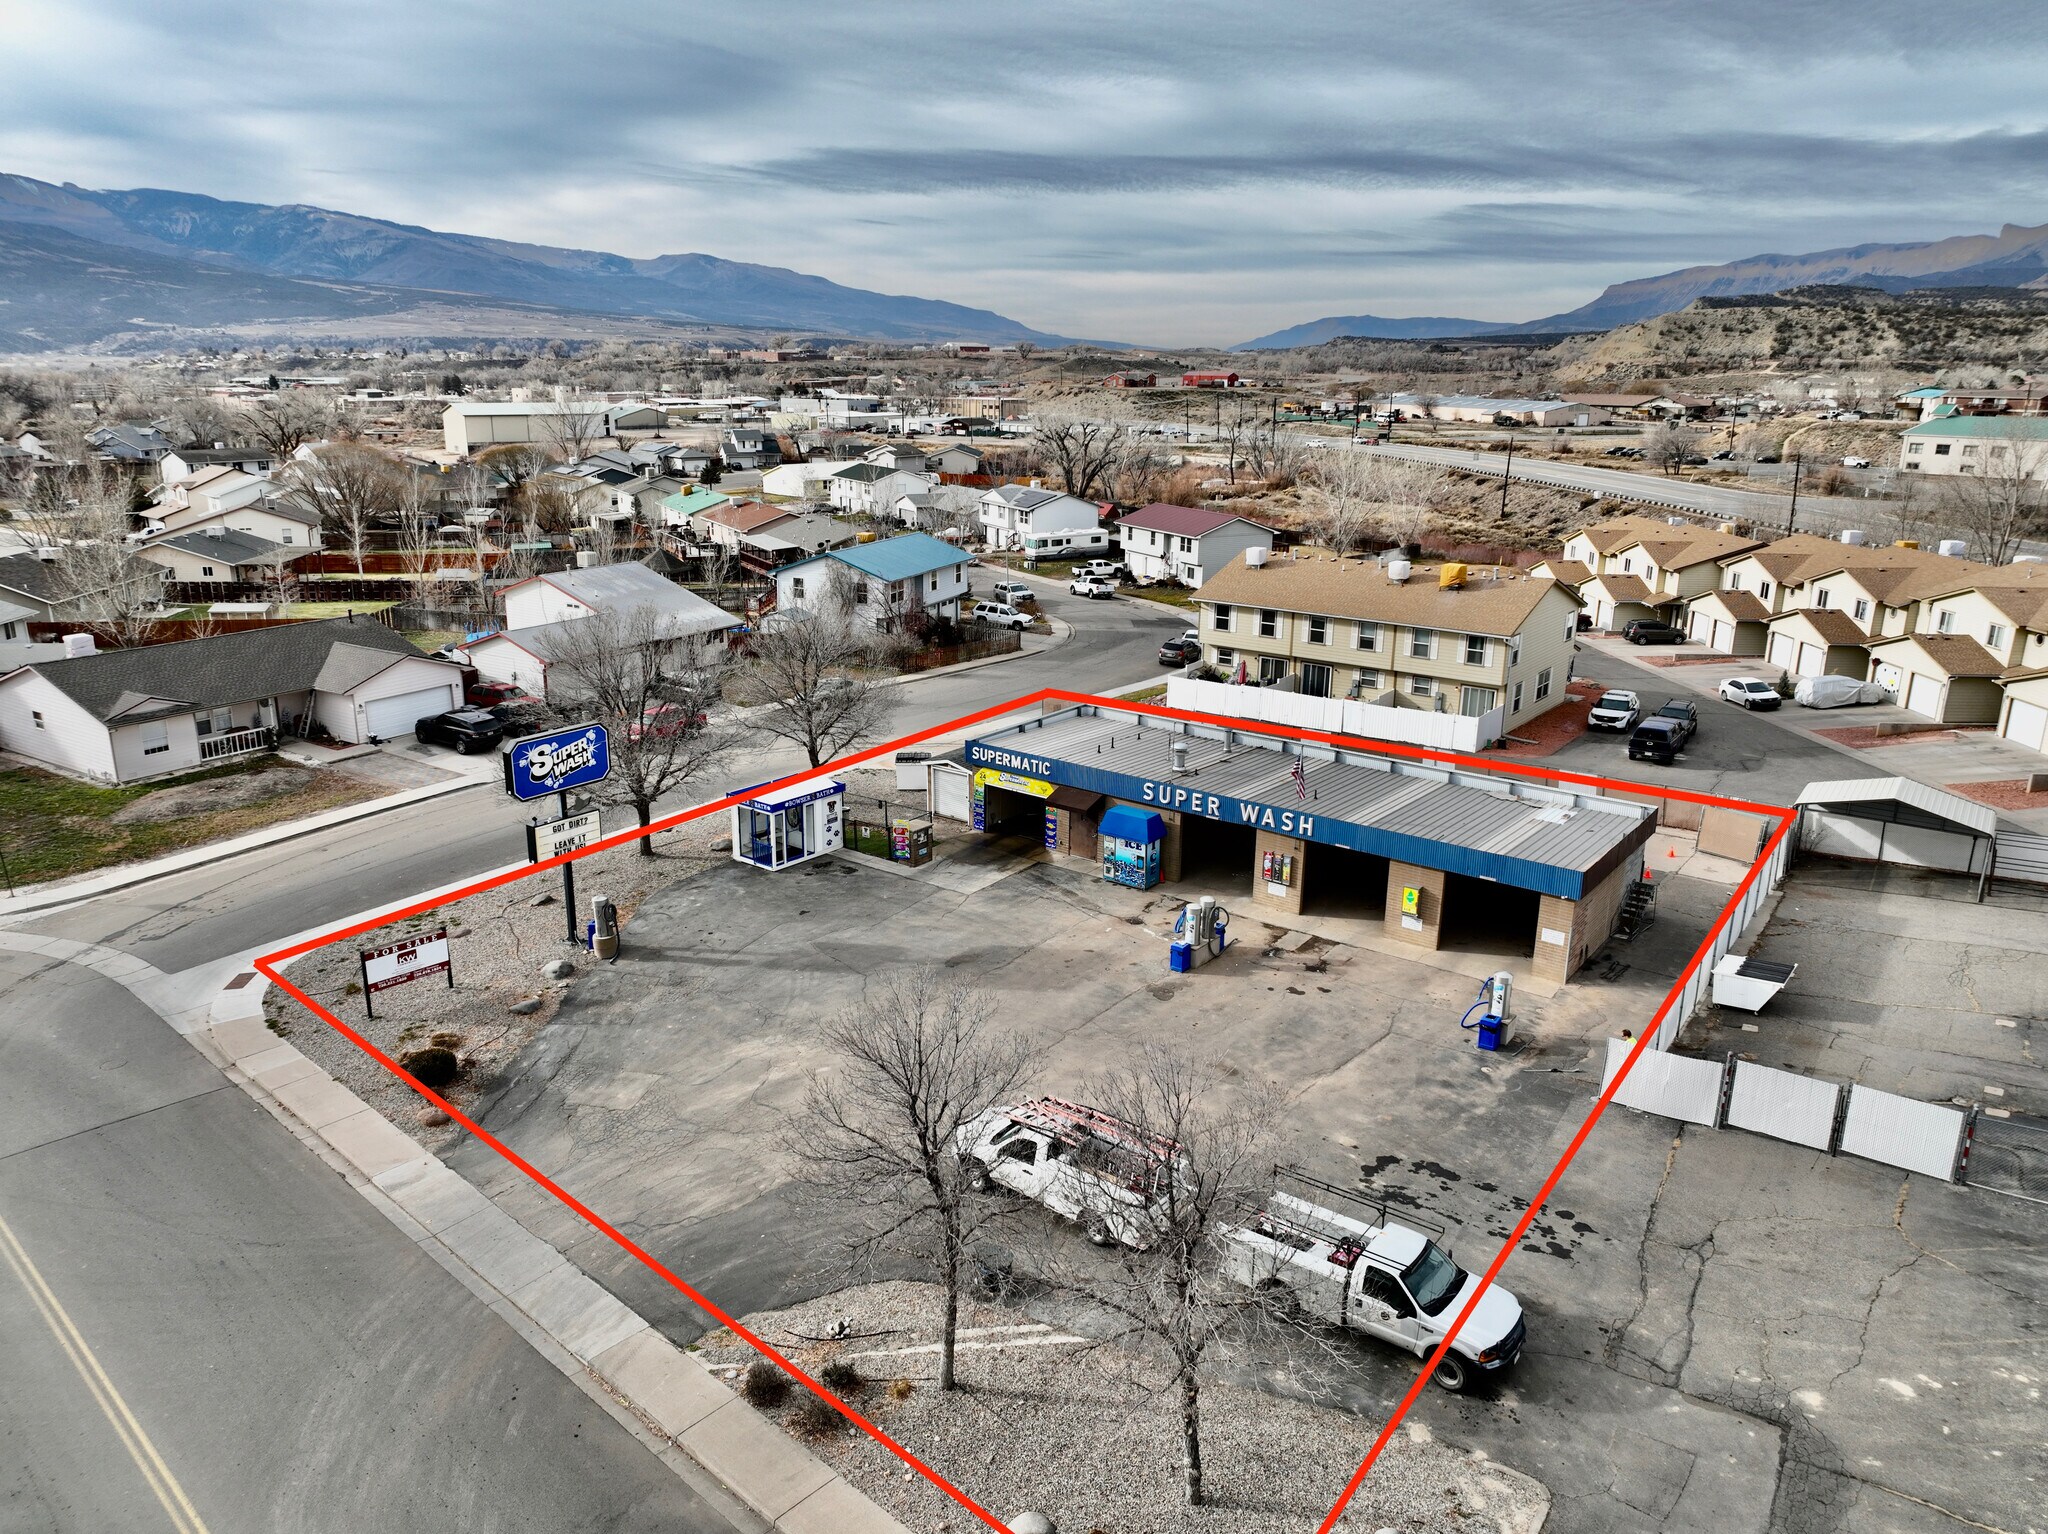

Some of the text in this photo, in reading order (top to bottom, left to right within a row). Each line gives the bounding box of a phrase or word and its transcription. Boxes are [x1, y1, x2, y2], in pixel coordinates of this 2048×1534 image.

[530, 737, 588, 777] SUPER
[553, 750, 592, 777] WASH
[972, 746, 1051, 776] SUPERMATIC
[788, 789, 831, 807] BOWSER BATH
[1143, 782, 1314, 837] SUPER WASH
[552, 817, 588, 833] GOT DIRT?
[554, 834, 586, 850] LEAVE IT
[1125, 840, 1142, 851] ICE
[373, 934, 438, 959] FOR SALE
[399, 953, 417, 964] KW
